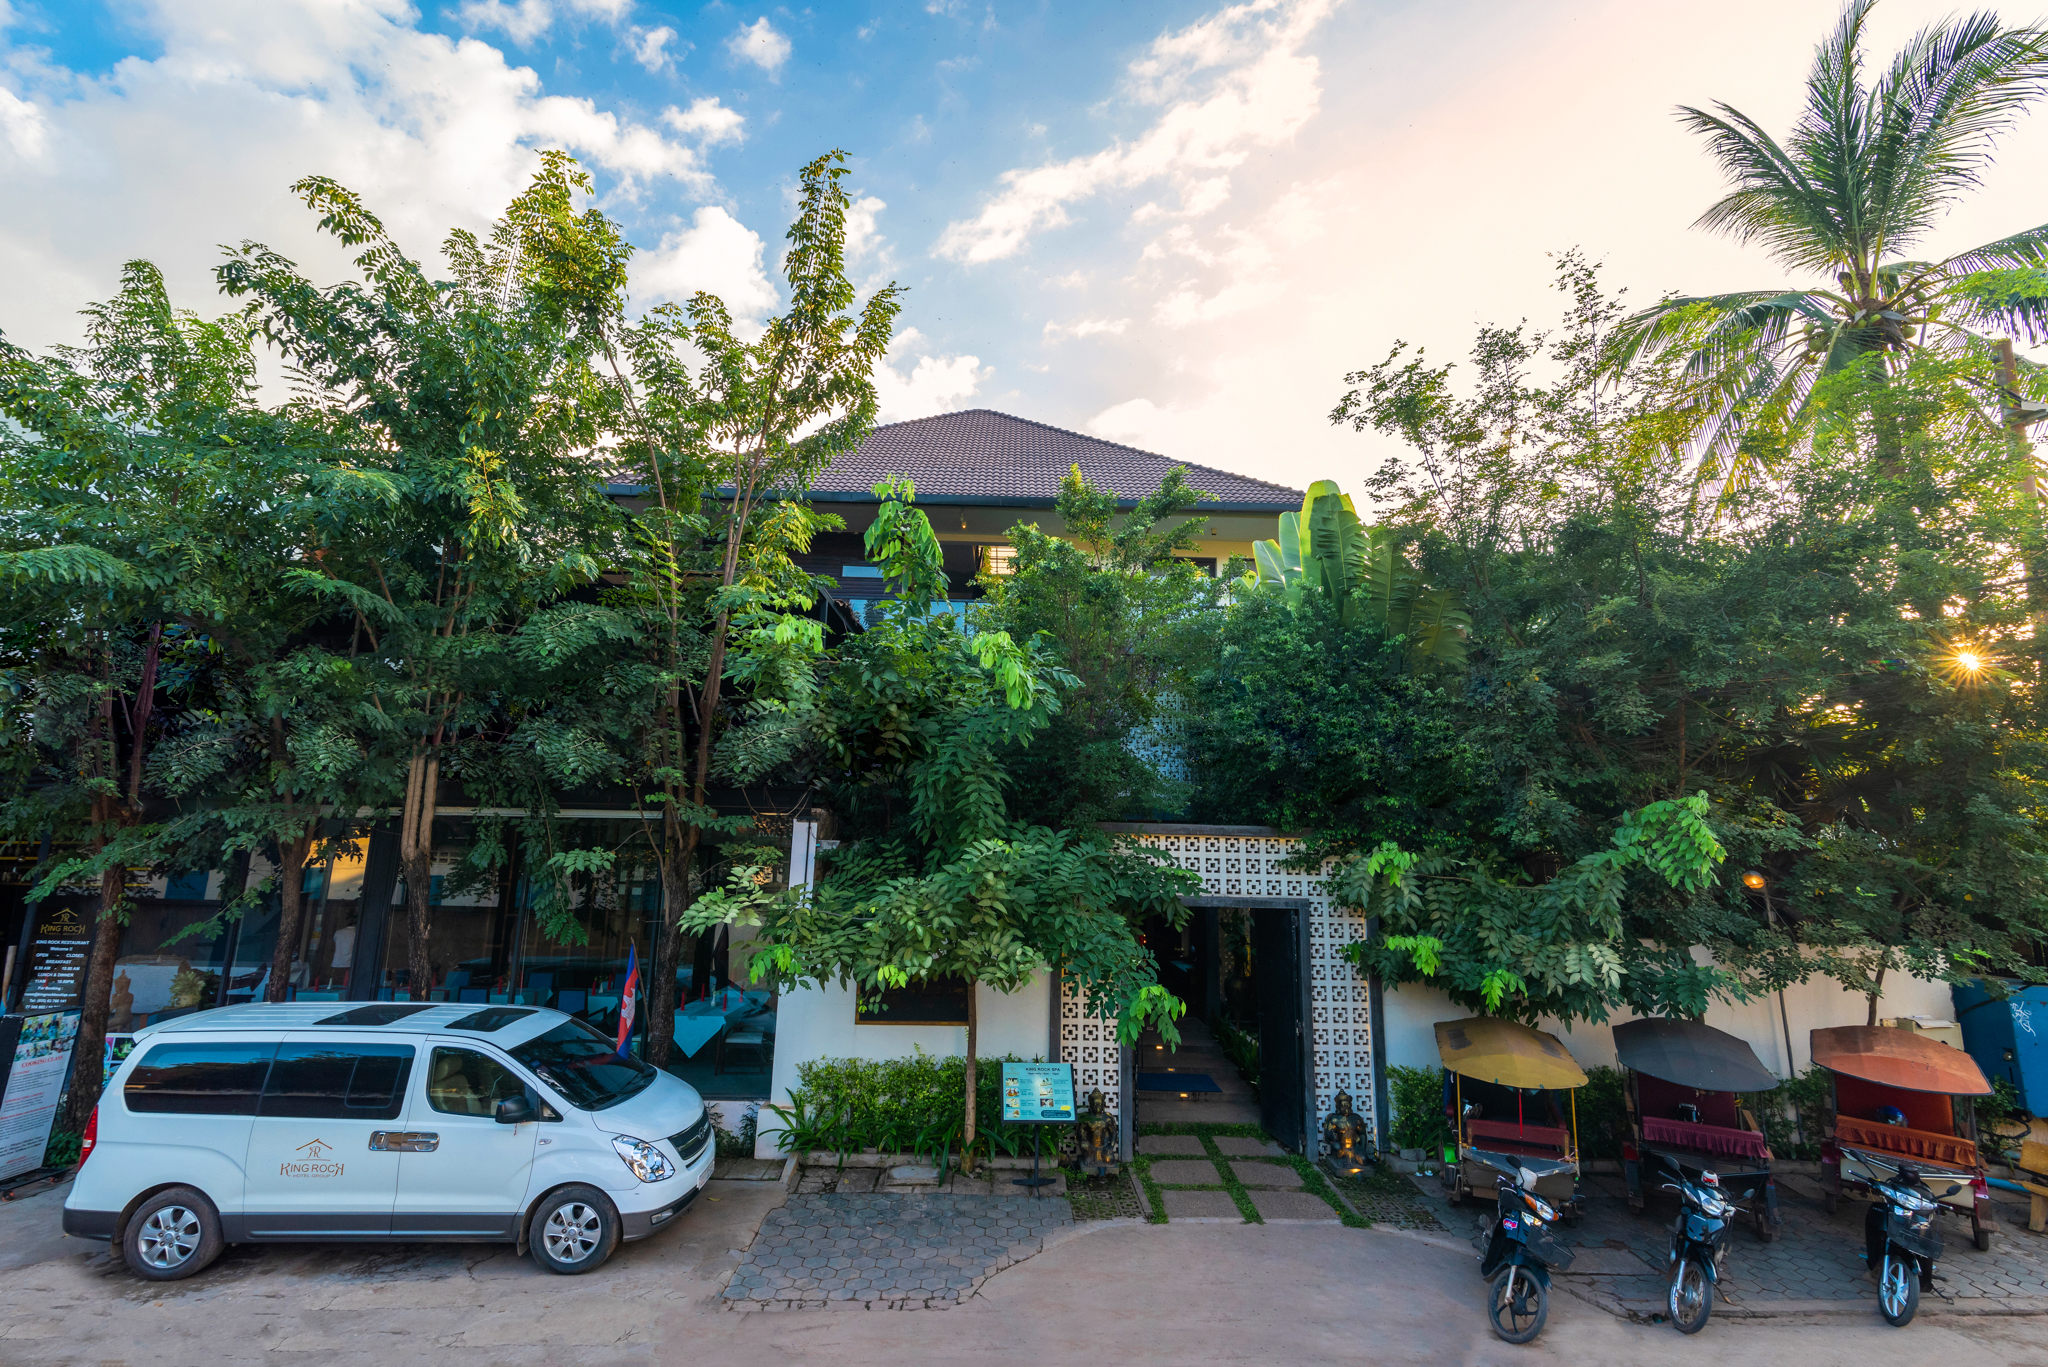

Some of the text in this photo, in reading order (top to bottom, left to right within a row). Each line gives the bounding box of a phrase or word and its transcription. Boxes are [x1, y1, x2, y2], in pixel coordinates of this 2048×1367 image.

[40, 924, 86, 935] KING ROCK
[21, 1059, 46, 1067] COOKING
[280, 1163, 345, 1177] KING ROCK
